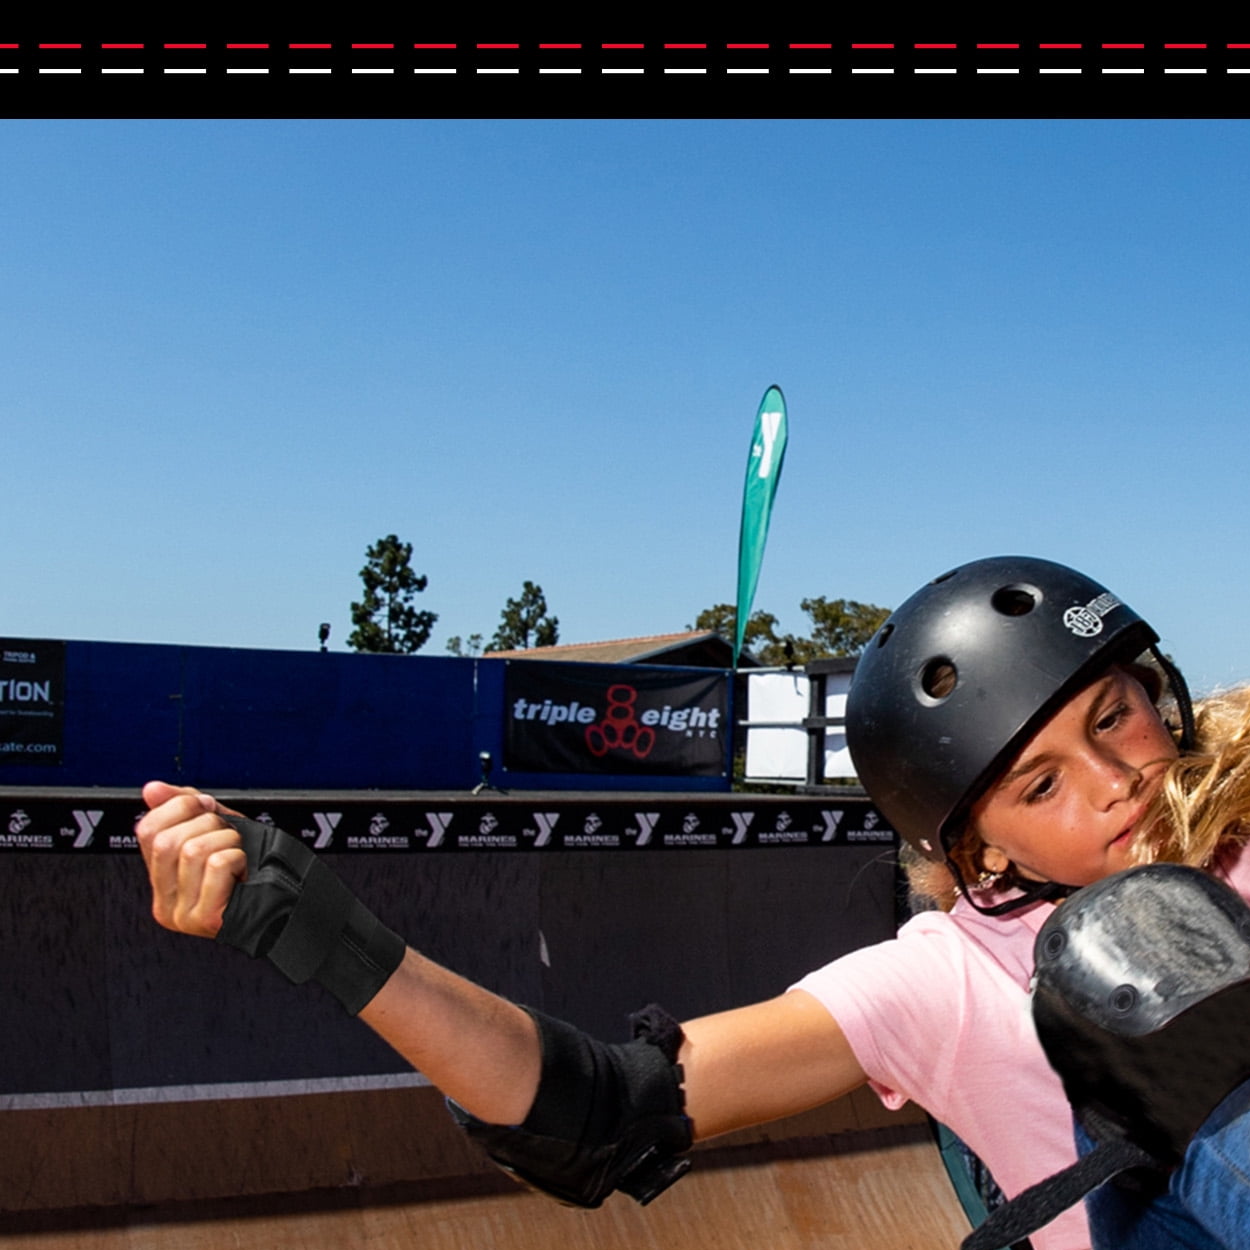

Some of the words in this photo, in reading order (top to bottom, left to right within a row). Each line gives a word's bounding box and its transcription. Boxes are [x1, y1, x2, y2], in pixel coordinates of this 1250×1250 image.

[513, 698, 597, 726] triple
[641, 706, 720, 732] eight
[348, 836, 409, 844] MARINES
[758, 832, 808, 840] MARINES
